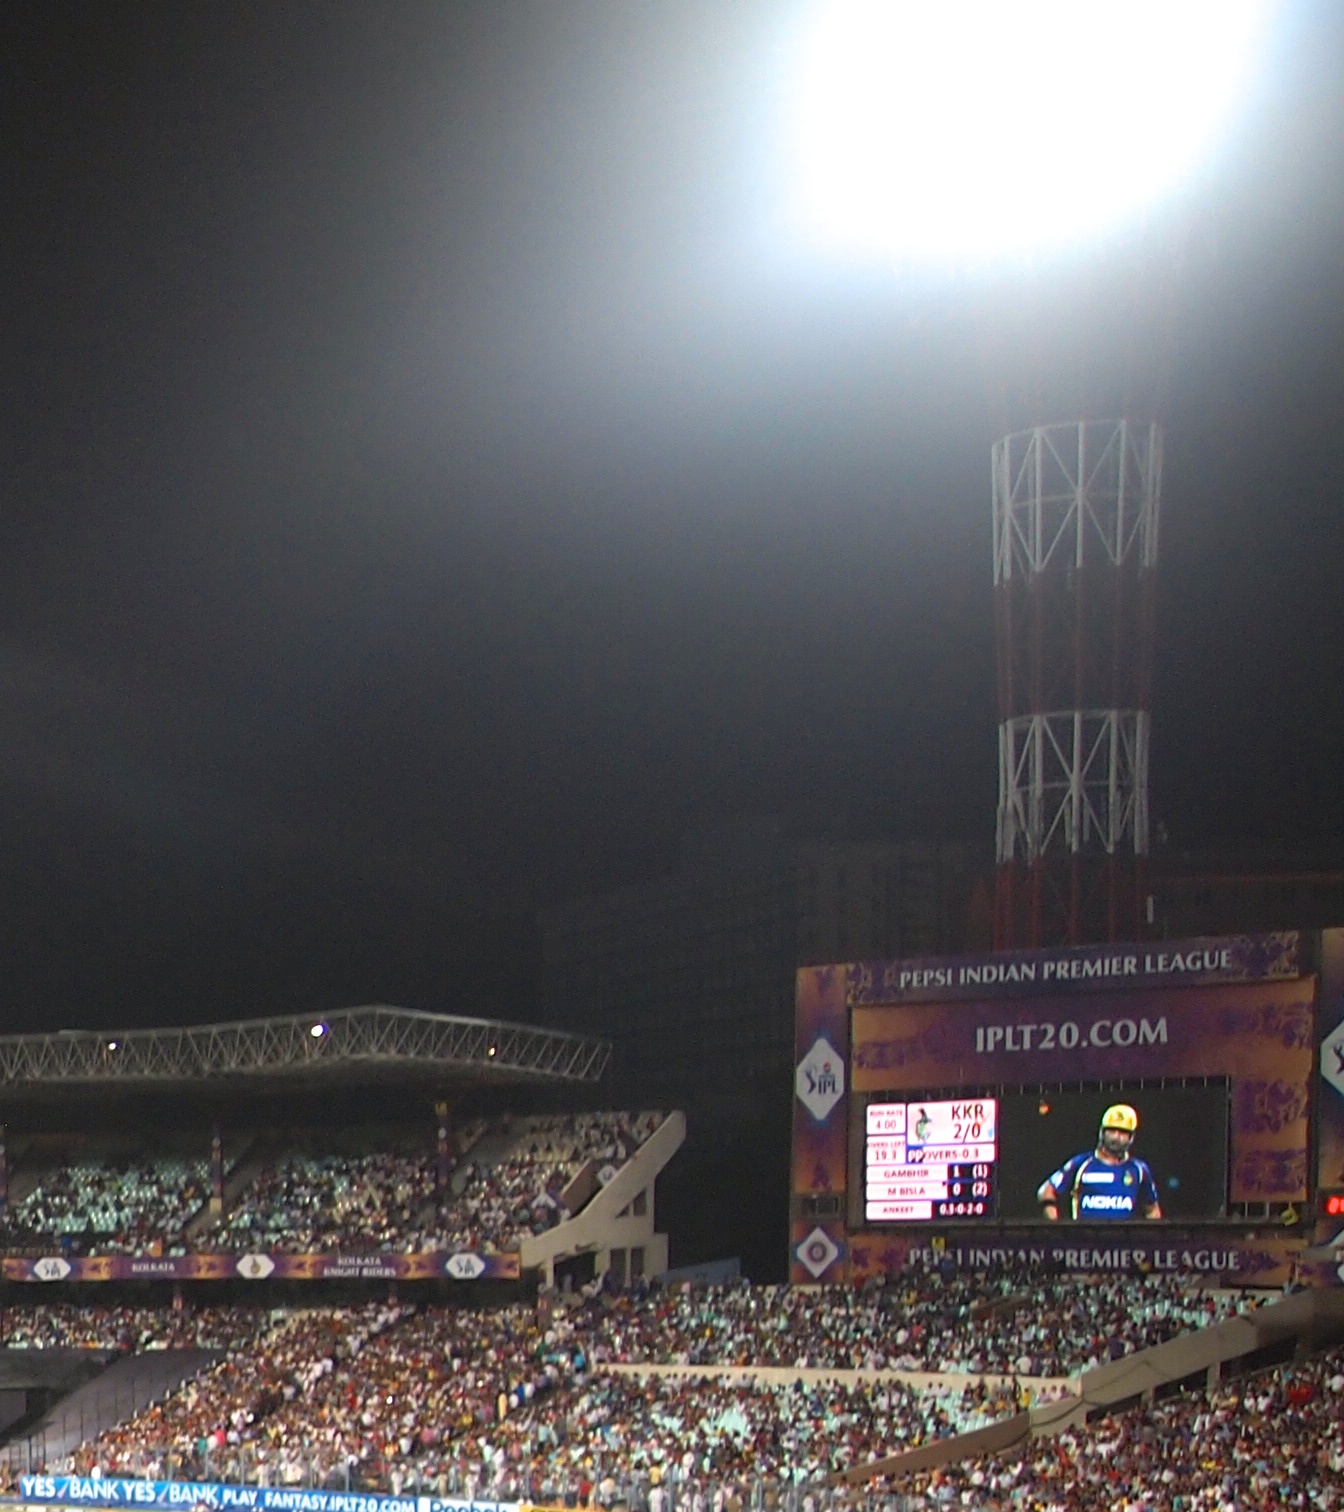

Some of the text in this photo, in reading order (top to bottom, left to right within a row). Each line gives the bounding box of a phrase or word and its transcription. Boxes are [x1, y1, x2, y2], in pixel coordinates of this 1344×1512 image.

[900, 950, 1231, 988] PEPSI INDIAN PREMIER LEAGUE
[976, 1017, 1168, 1053] IPLT20.COM
[952, 1104, 984, 1120] KKR
[953, 1123, 981, 1143] 2/0
[884, 1169, 929, 1178] GAMBHIR
[900, 1187, 925, 1195] BISLA
[972, 1182, 988, 1197] (2)
[1082, 1195, 1132, 1211] NOKIA
[22, 1477, 119, 1500] YES BANK
[122, 1480, 218, 1504] YES BANK
[223, 1489, 258, 1507] PLAY
